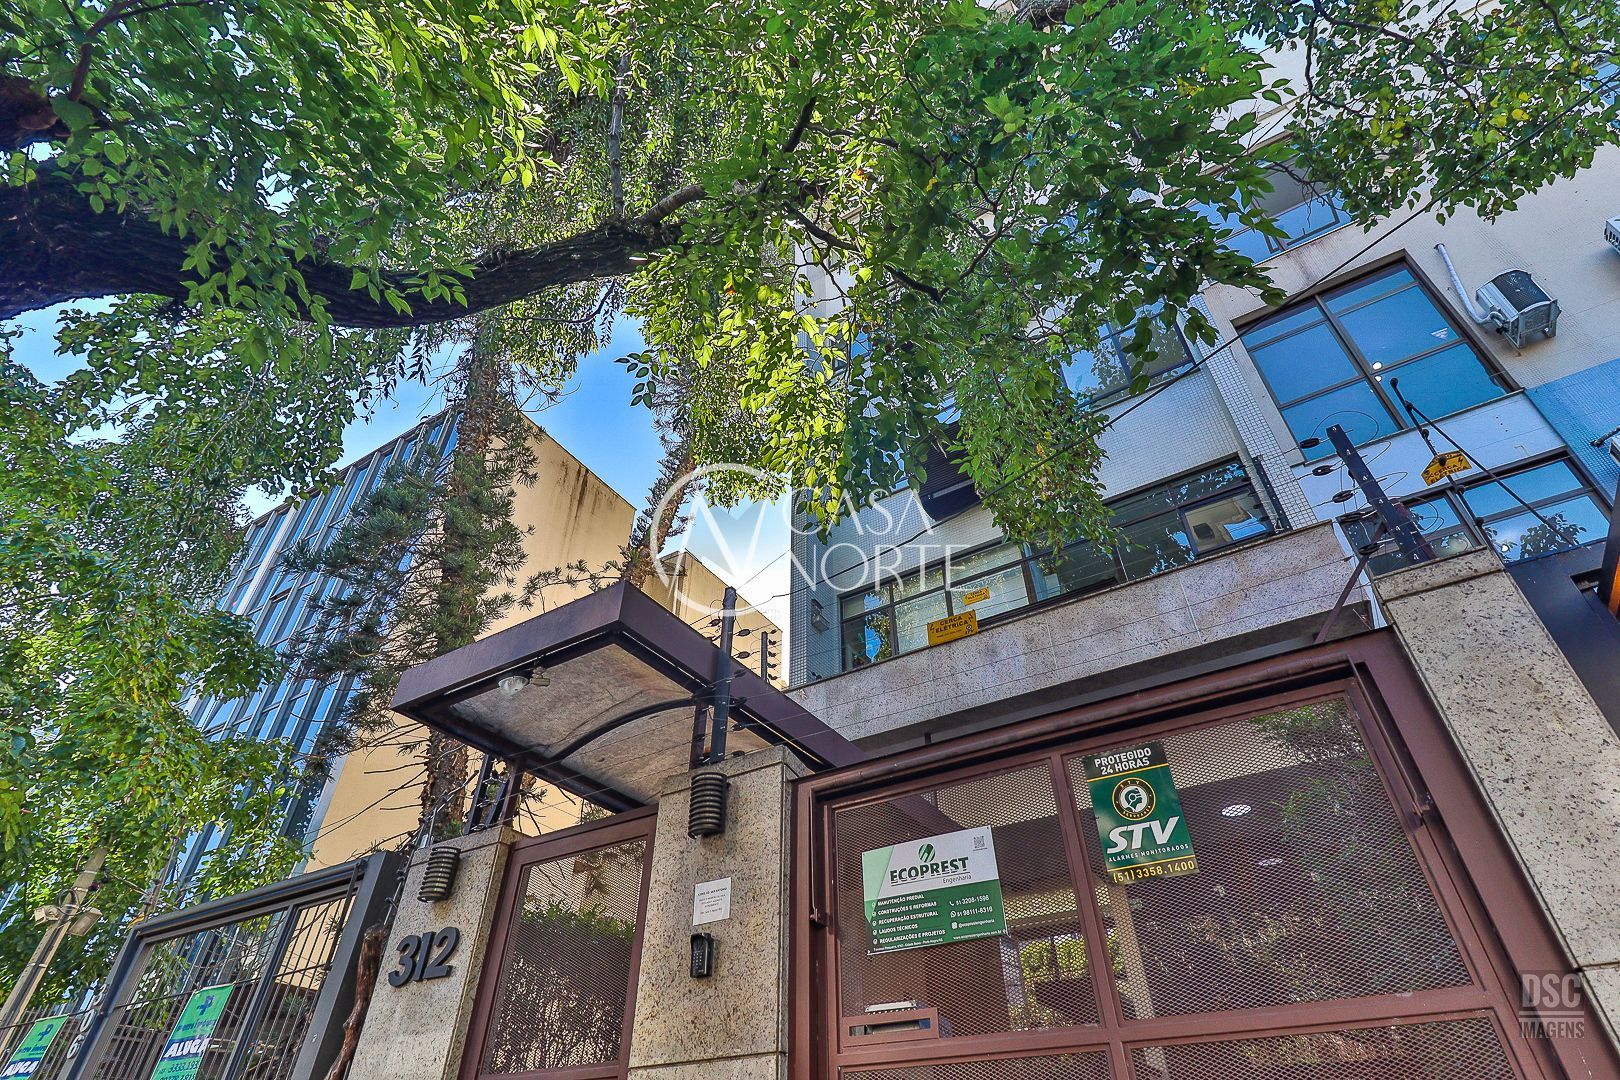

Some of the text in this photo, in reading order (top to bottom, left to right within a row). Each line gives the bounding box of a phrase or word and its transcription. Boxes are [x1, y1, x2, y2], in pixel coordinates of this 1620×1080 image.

[940, 615, 962, 626] CERCA
[1094, 747, 1151, 768] PROTEGIDO
[1101, 757, 1150, 775] 24 HORAS
[1107, 816, 1180, 854] STV
[1108, 843, 1189, 863] ALARMES MONITORADOS
[889, 857, 969, 884] ECOPREST
[943, 874, 972, 884] Engenharia
[877, 896, 906, 906] MANUTENÇÃO
[878, 905, 909, 915] CONSTRUÇÕES
[913, 901, 937, 909] REFORMAS
[878, 911, 938, 925] RECUPERAÇÃO ESTRUTURAL
[878, 926, 896, 934] LAUDOS
[879, 933, 918, 944] REGULARIZAÇÕES
[922, 929, 946, 938] PROJETOS
[388, 926, 460, 988] 312
